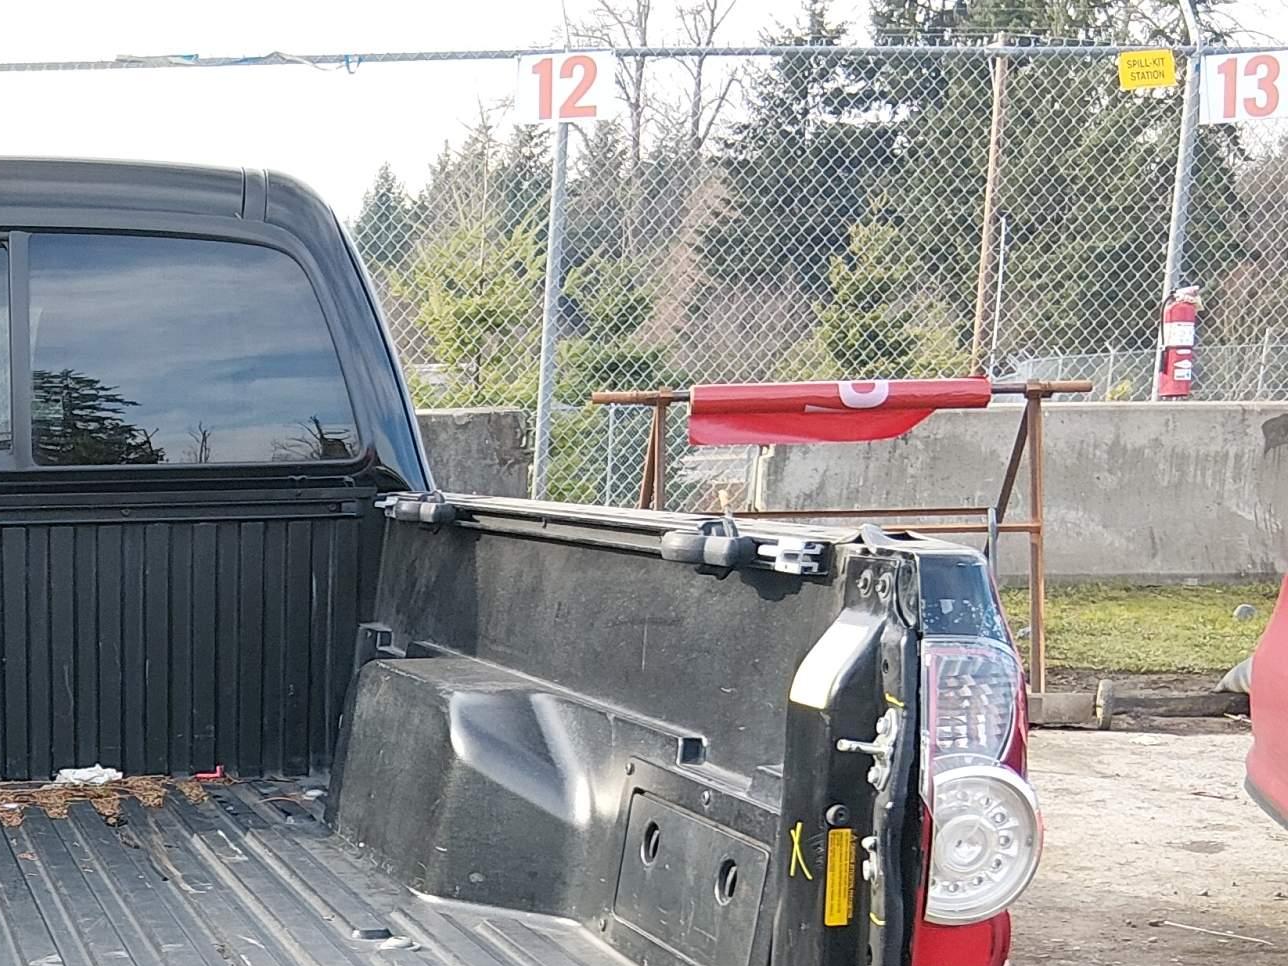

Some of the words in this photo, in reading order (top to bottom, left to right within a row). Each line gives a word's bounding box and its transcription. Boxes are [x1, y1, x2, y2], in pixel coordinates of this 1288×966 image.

[1126, 57, 1165, 69] SPILL-KIT
[1130, 70, 1165, 81] STATION
[531, 55, 598, 120] 12
[1217, 54, 1281, 118] 13
